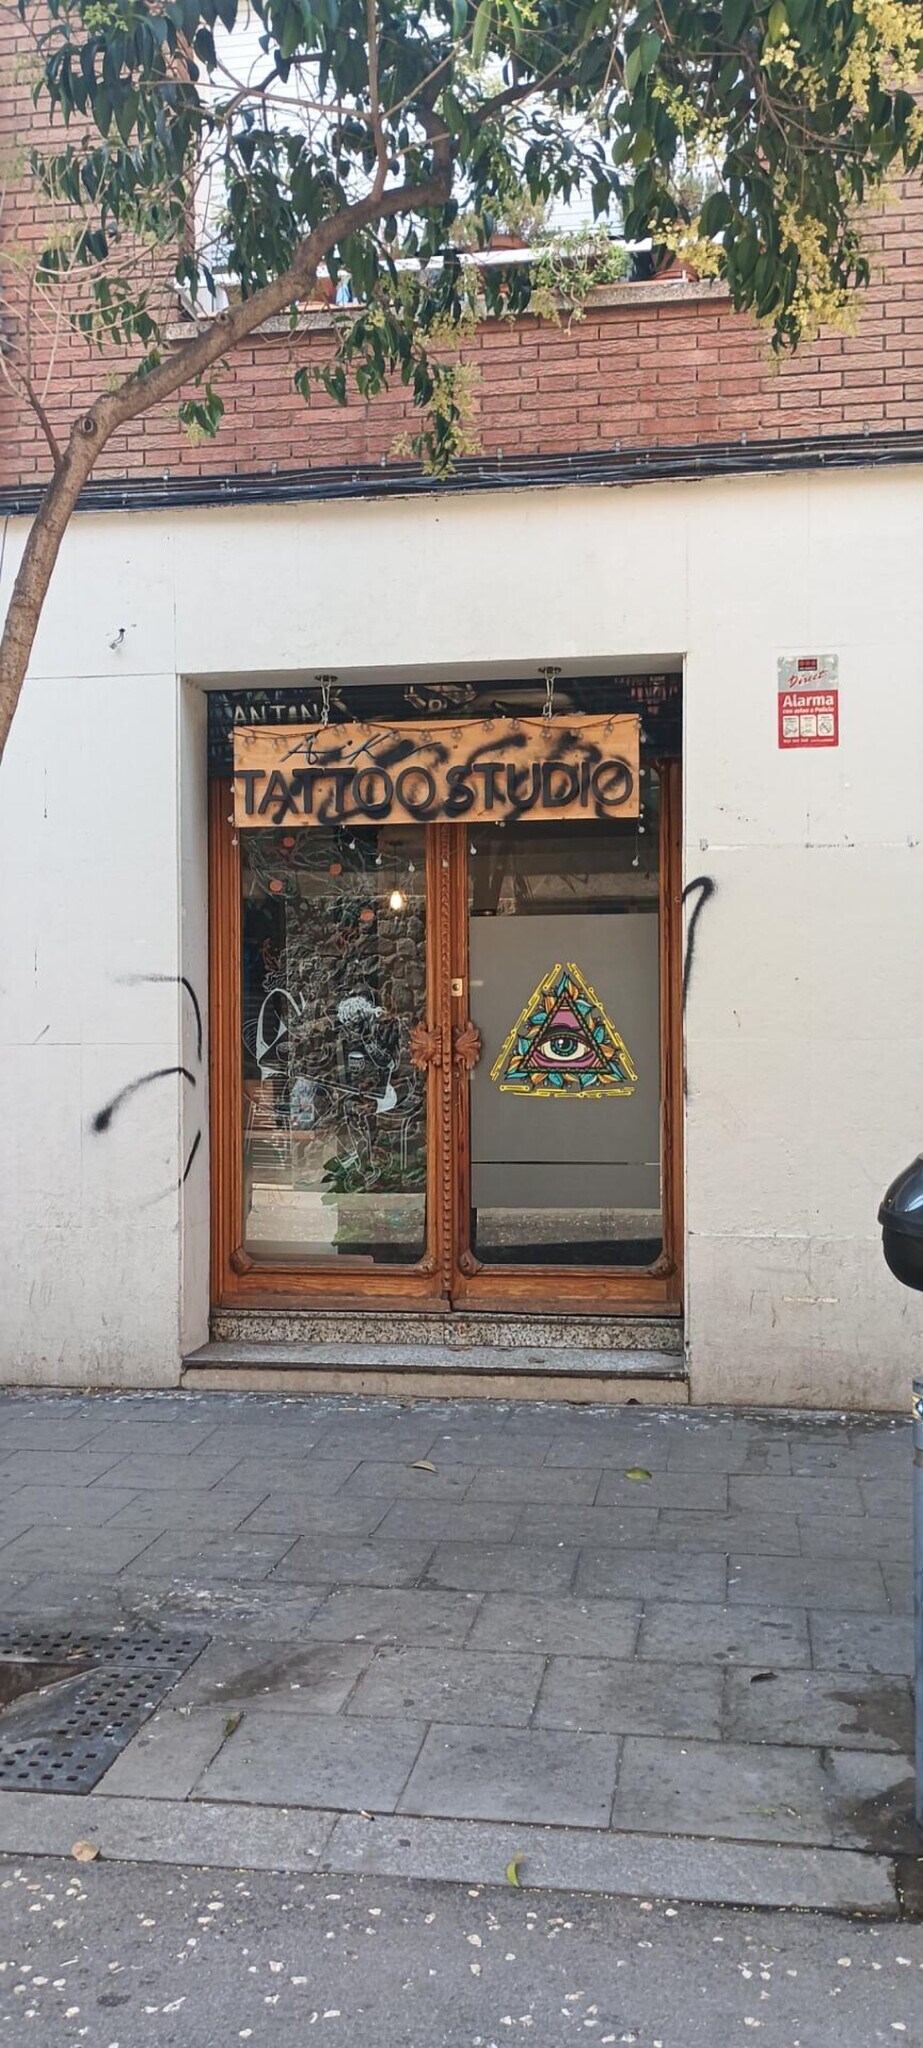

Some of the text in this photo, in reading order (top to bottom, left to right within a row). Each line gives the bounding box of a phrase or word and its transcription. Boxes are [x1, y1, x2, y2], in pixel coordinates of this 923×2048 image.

[783, 694, 833, 707] Alarma
[234, 760, 634, 815] TATTOO STUDIO
